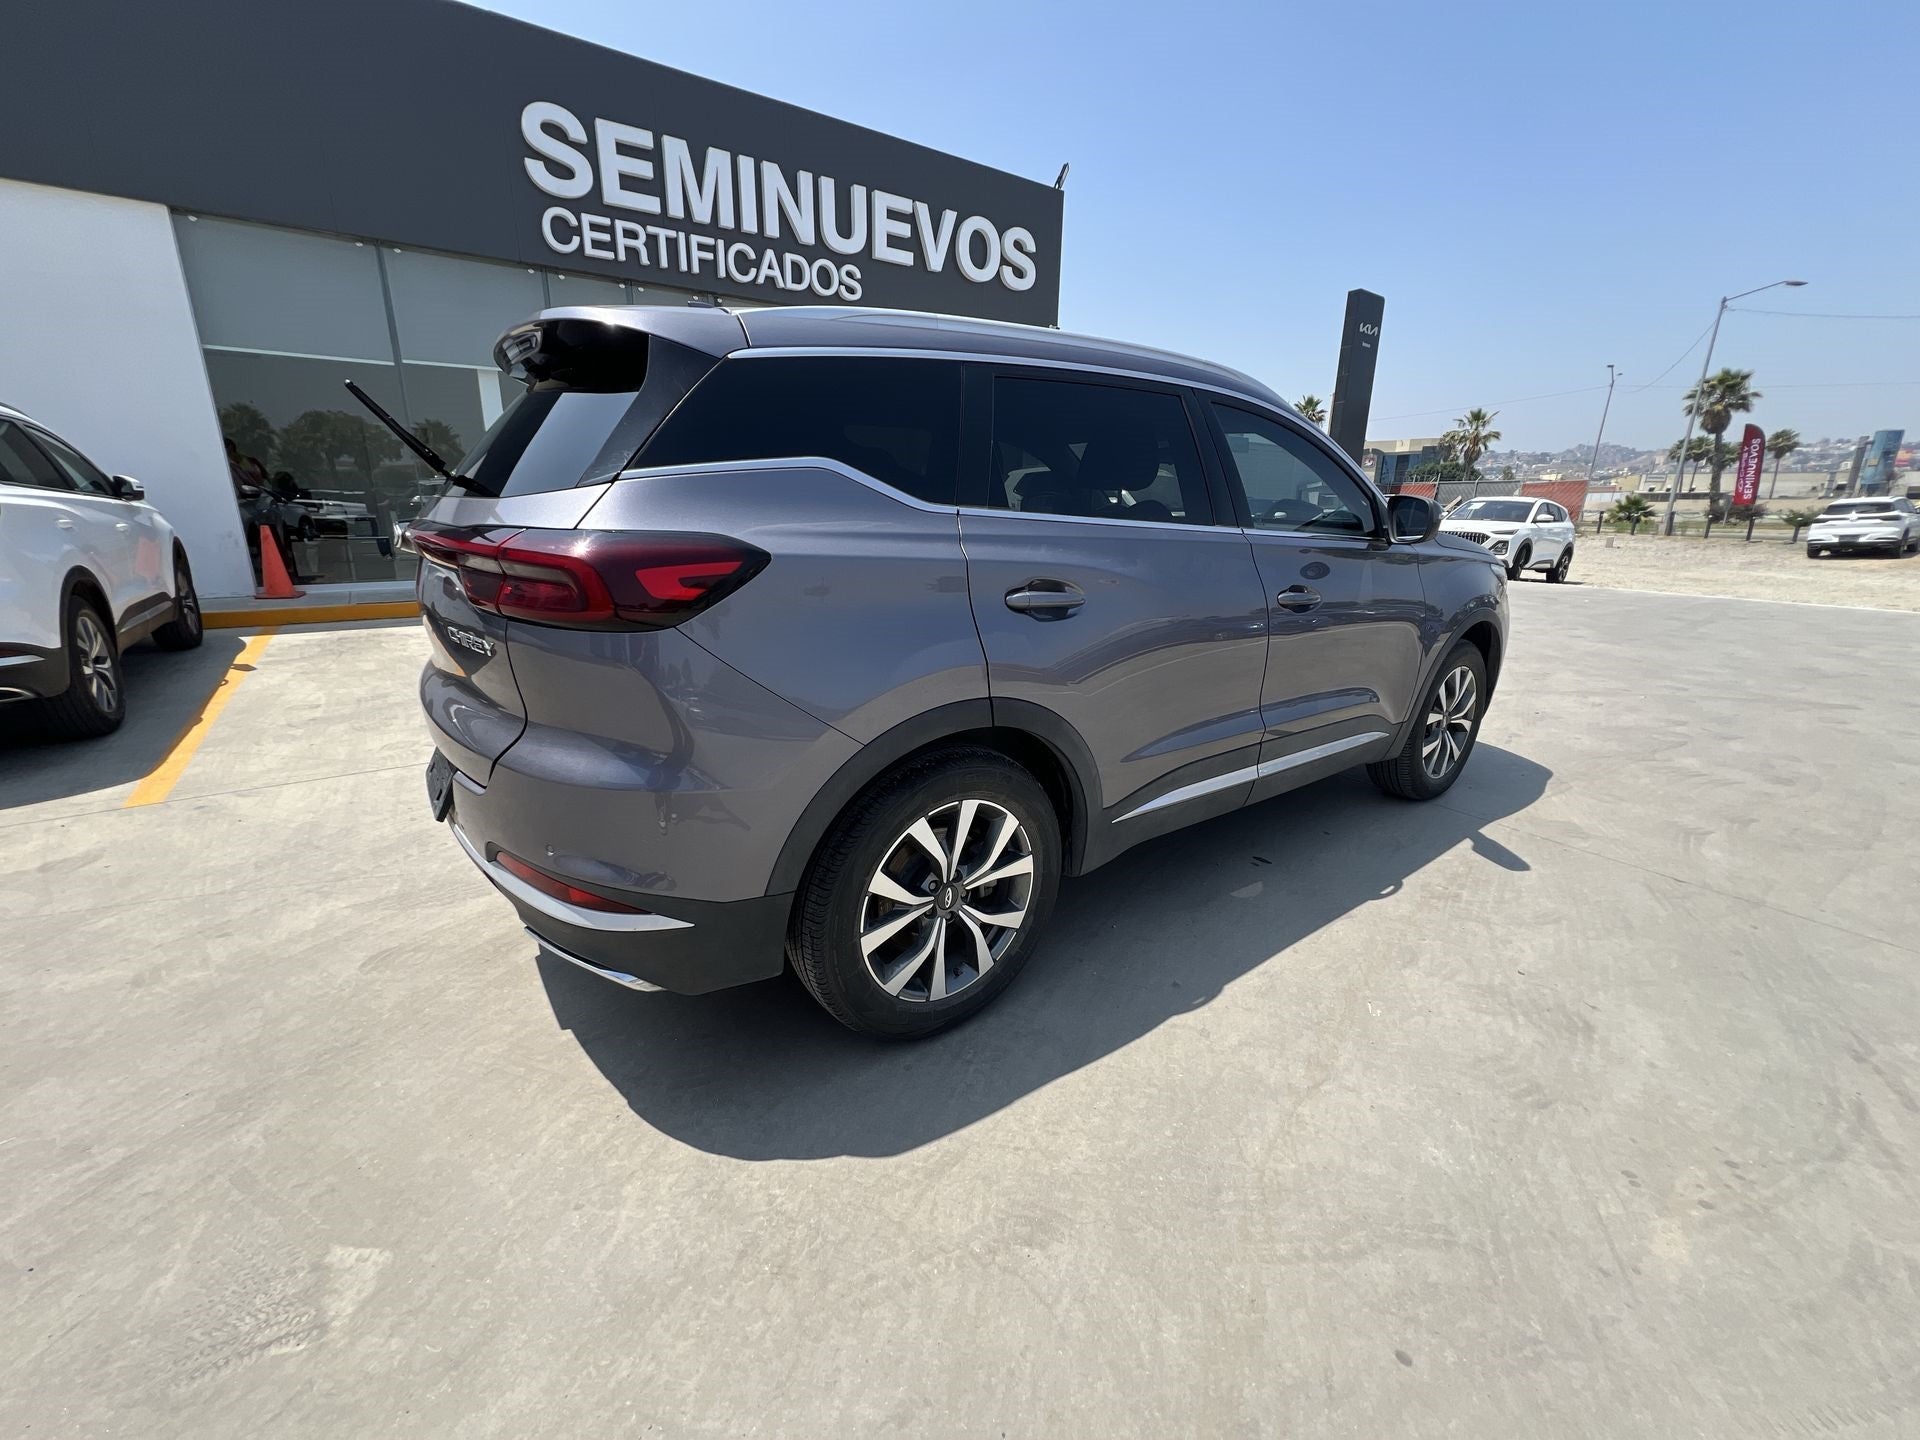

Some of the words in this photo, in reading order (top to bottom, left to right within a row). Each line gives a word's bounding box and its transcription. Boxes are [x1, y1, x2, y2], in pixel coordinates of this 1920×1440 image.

[521, 101, 1037, 291] SEMINUEVOS
[541, 207, 863, 302] CERTIFICADOS
[1359, 322, 1379, 336] KIA
[1743, 438, 1762, 500] SEMINUEVOS
